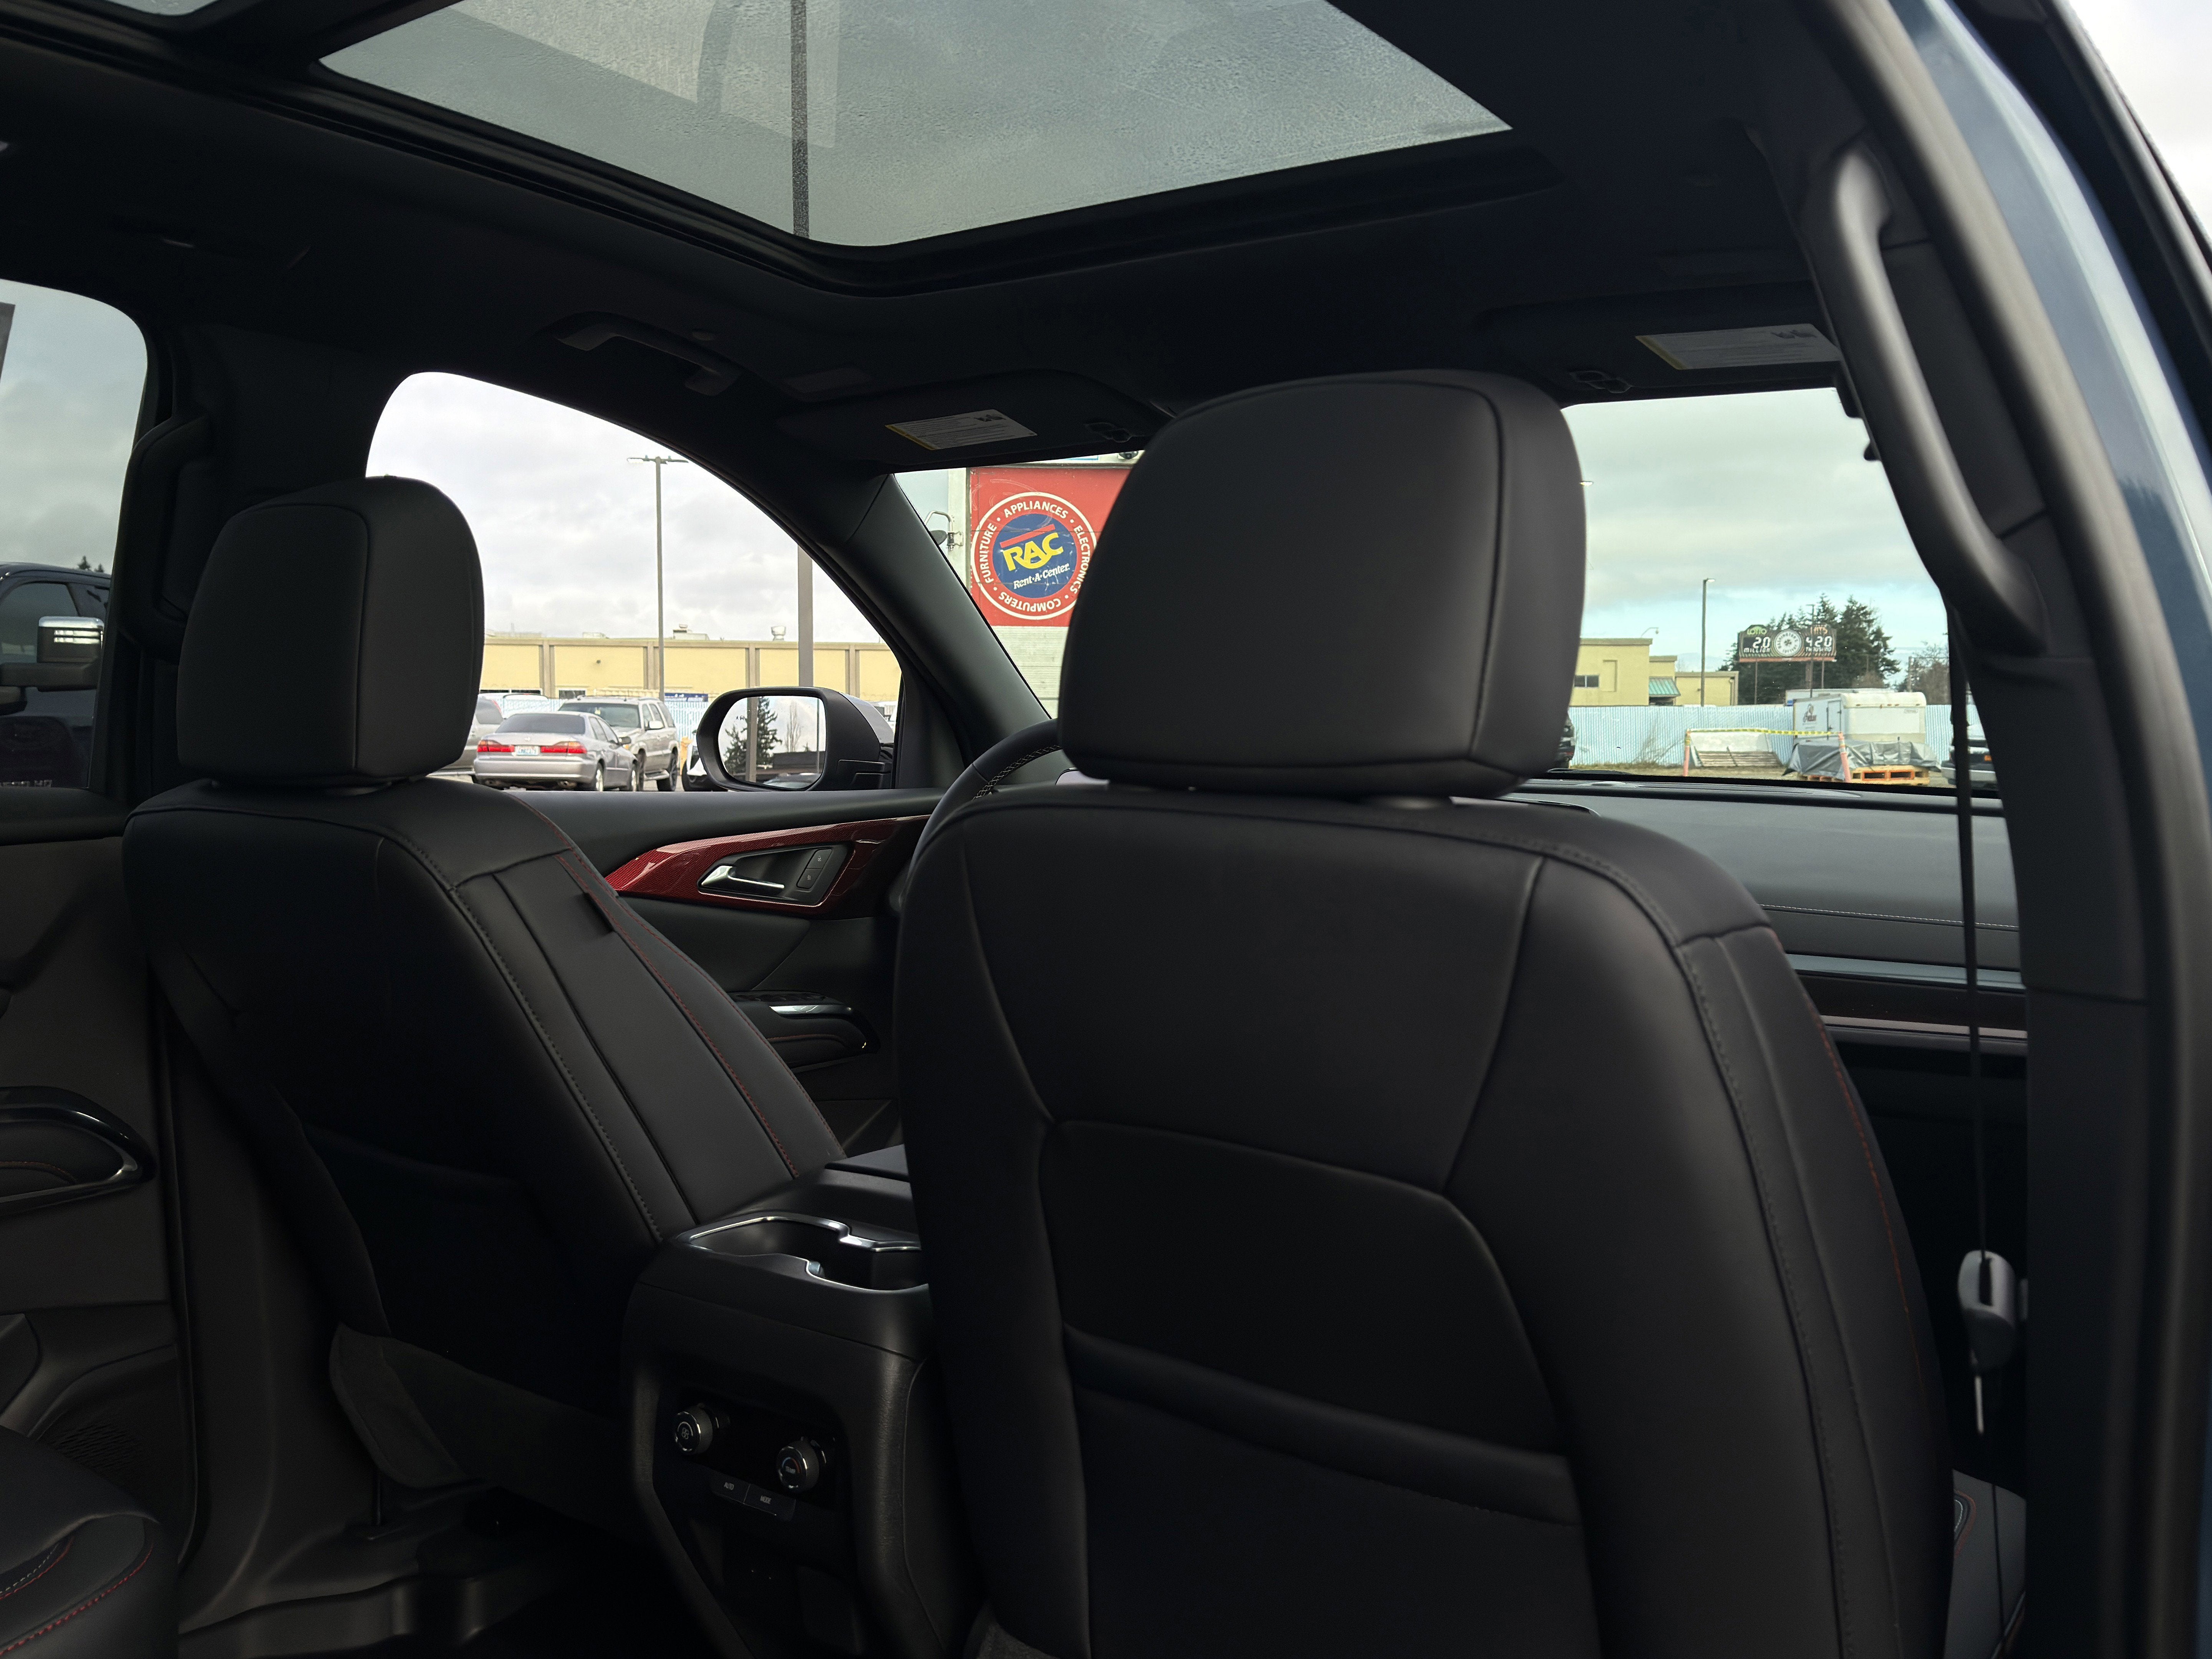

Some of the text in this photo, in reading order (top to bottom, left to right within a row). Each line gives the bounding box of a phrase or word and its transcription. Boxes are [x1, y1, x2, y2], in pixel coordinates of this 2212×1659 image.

[1004, 501, 1068, 519] APPLIANCES
[979, 523, 997, 584] FURNITURE
[1002, 532, 1064, 571] RAC
[1070, 525, 1090, 594] ELECTRONICS
[999, 592, 1061, 612] COMPUTERS
[1753, 637, 1770, 648] 20
[1806, 636, 1832, 647] 420
[724, 1482, 734, 1490] AUTO
